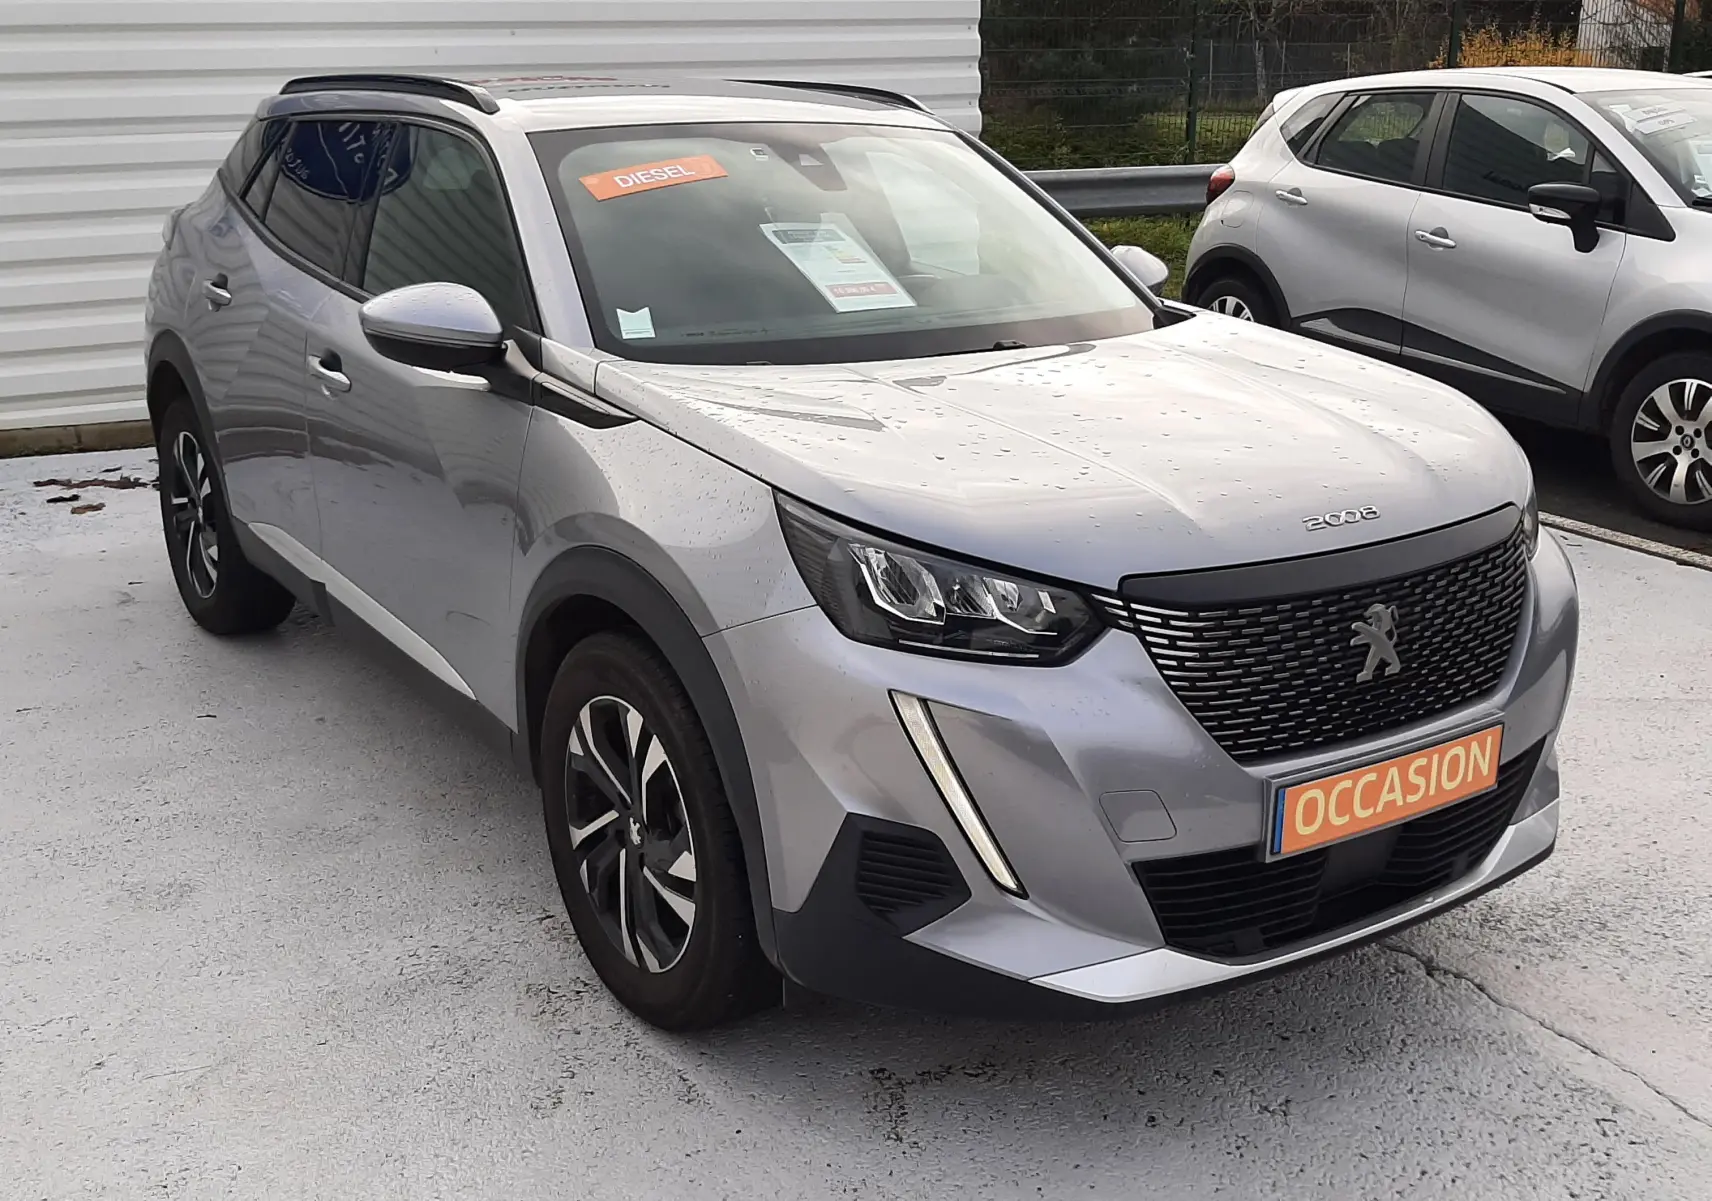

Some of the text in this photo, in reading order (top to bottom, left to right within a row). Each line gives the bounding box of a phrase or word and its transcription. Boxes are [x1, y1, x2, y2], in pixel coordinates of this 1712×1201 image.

[612, 164, 696, 188] DIESEL
[1302, 505, 1380, 532] 2008
[1294, 735, 1493, 835] OCCASION
